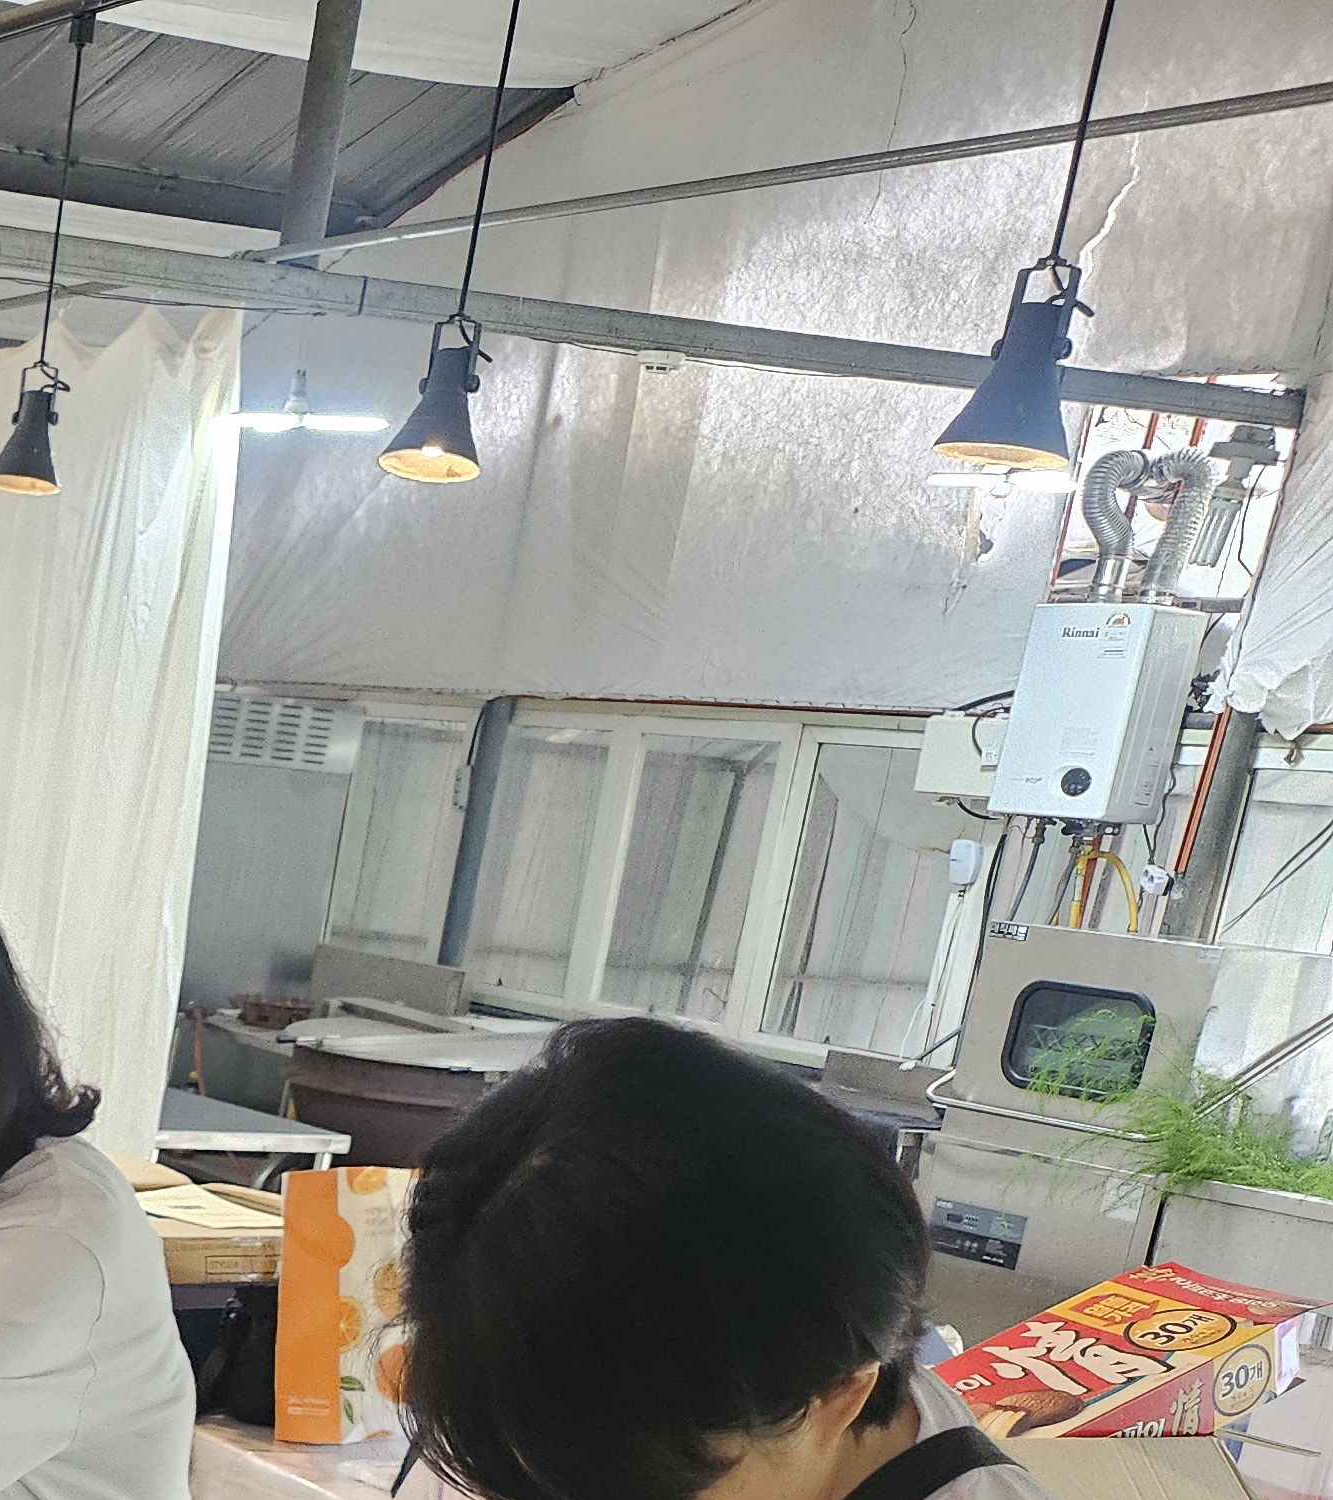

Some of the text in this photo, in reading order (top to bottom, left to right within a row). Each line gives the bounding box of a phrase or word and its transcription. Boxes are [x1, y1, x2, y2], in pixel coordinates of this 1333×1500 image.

[1062, 627, 1100, 639] Rinnai
[1137, 1311, 1217, 1347] 30개
[1220, 1360, 1265, 1399] 30개
